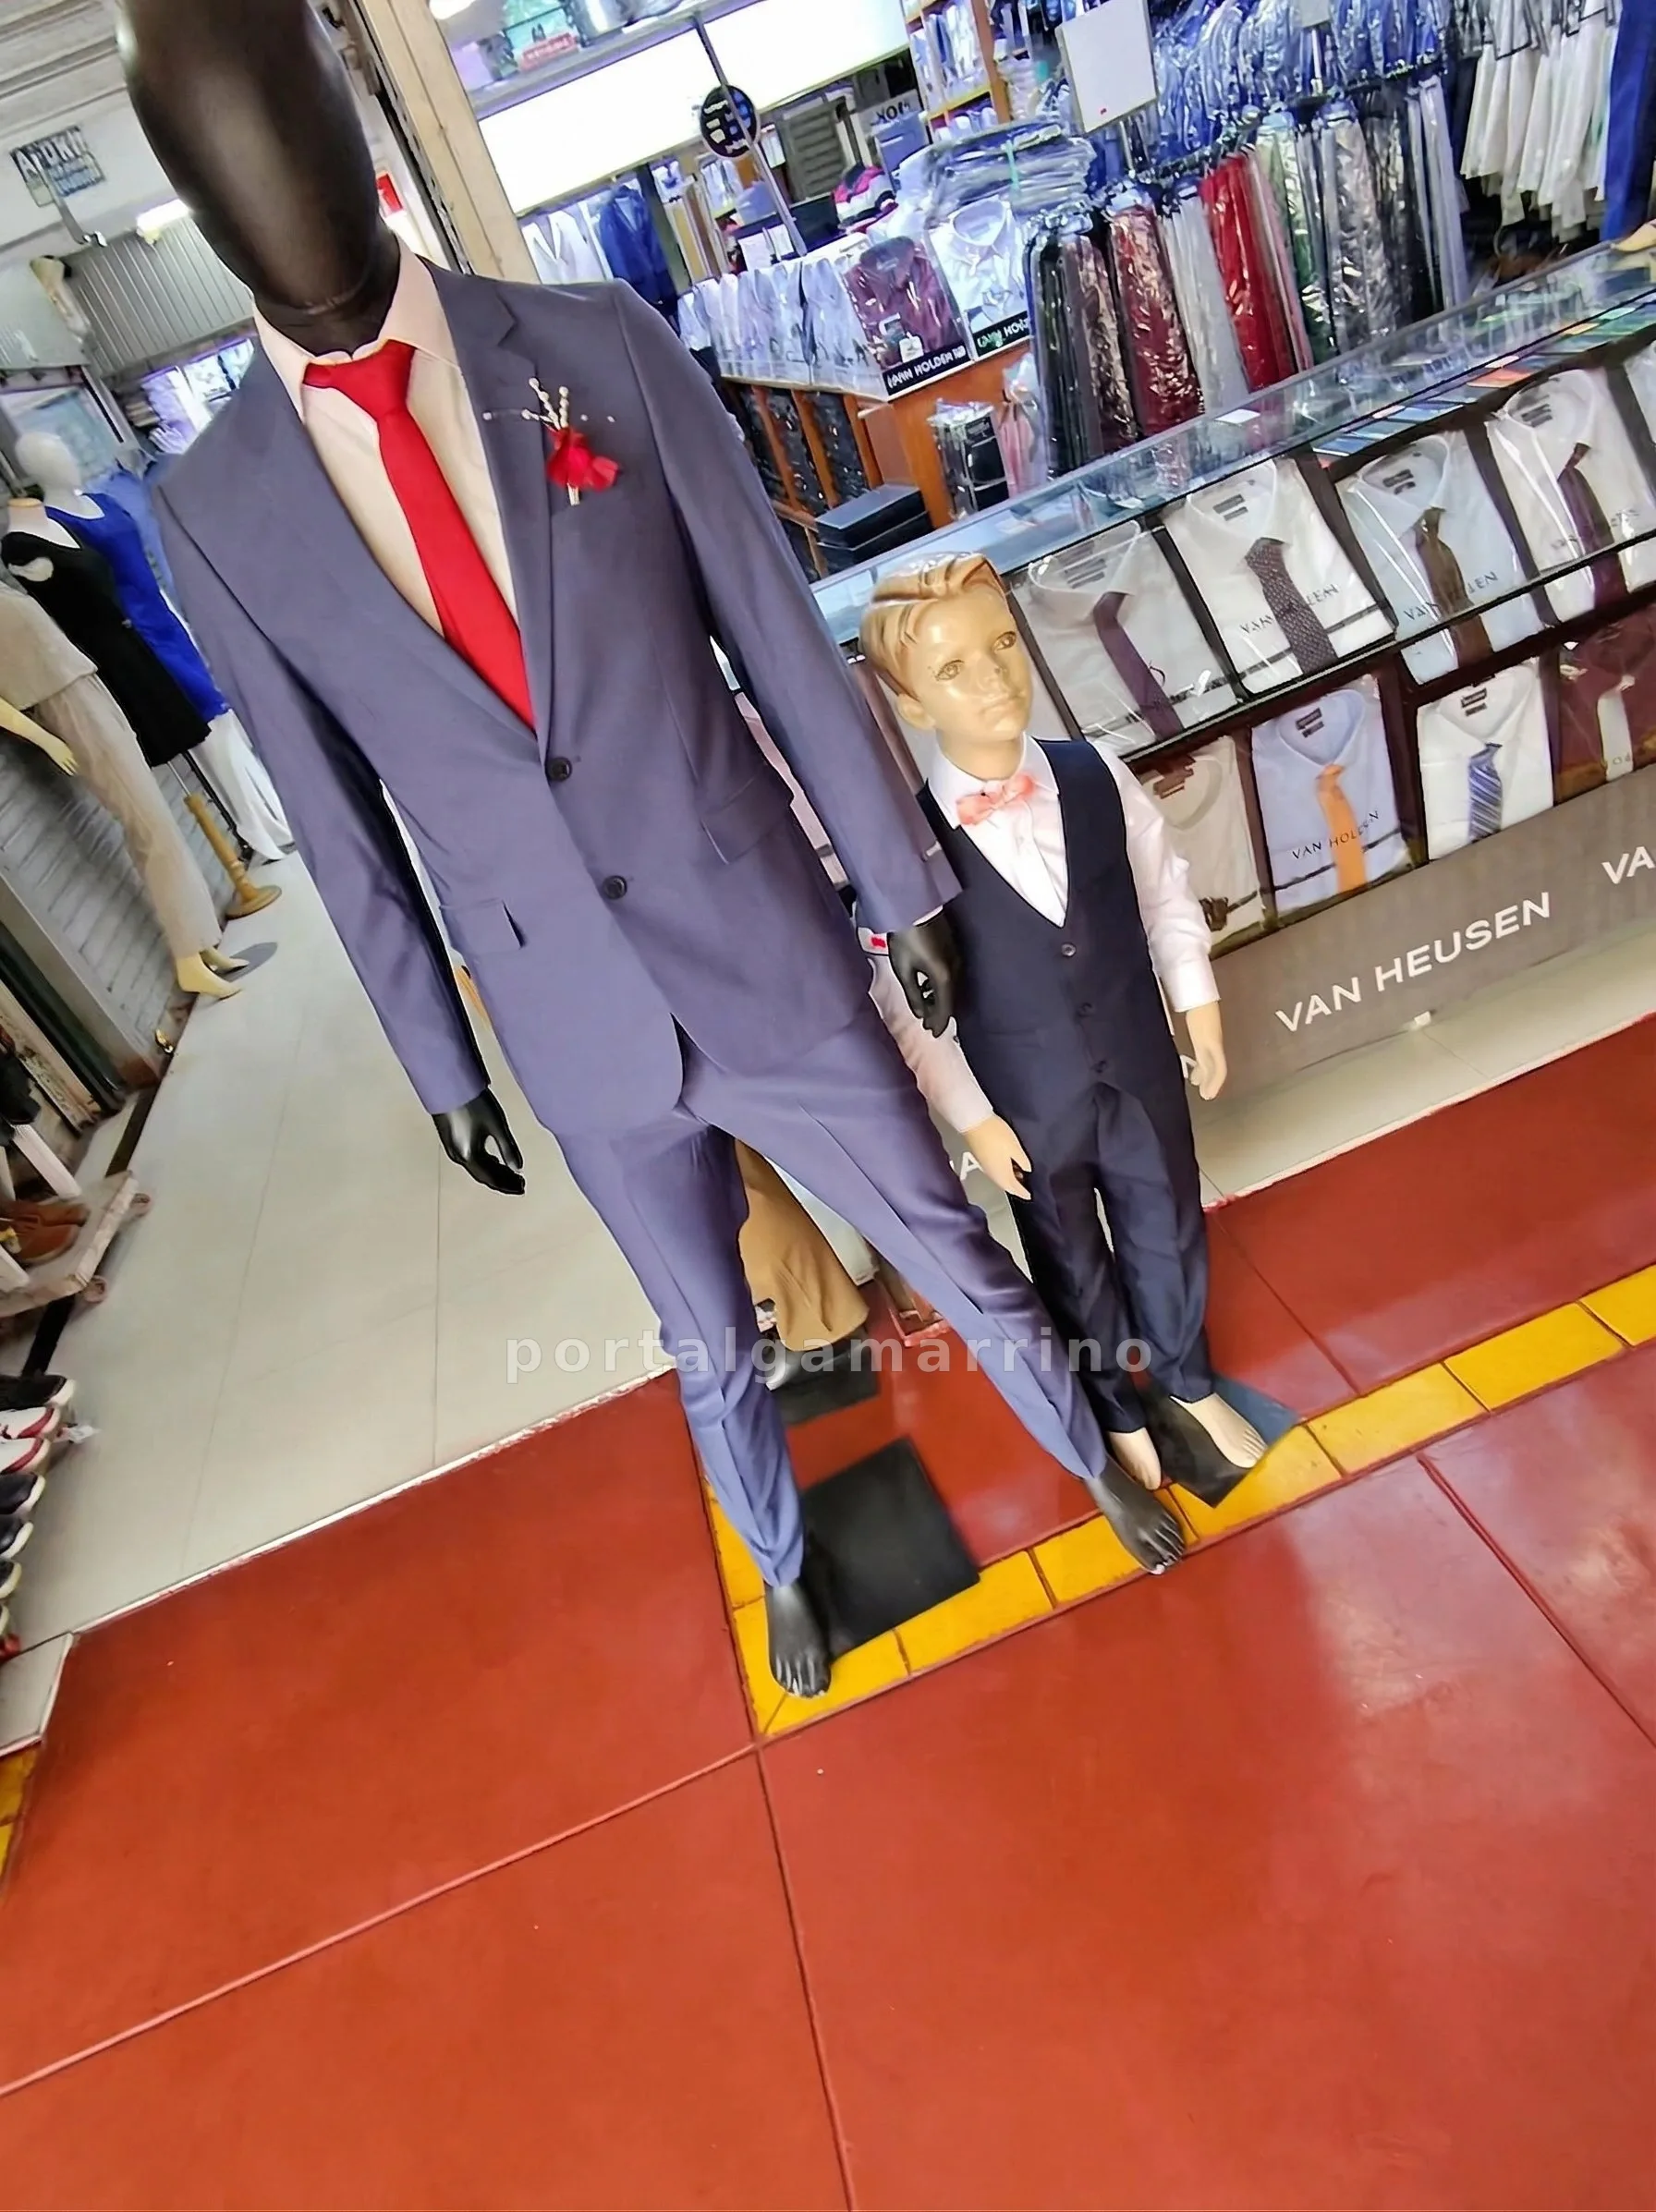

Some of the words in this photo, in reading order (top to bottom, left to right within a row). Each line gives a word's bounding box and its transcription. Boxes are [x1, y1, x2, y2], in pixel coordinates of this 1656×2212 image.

[1292, 842, 1322, 859] VAN
[1275, 976, 1362, 1032] VAN
[1374, 891, 1551, 992] HEUSEN
